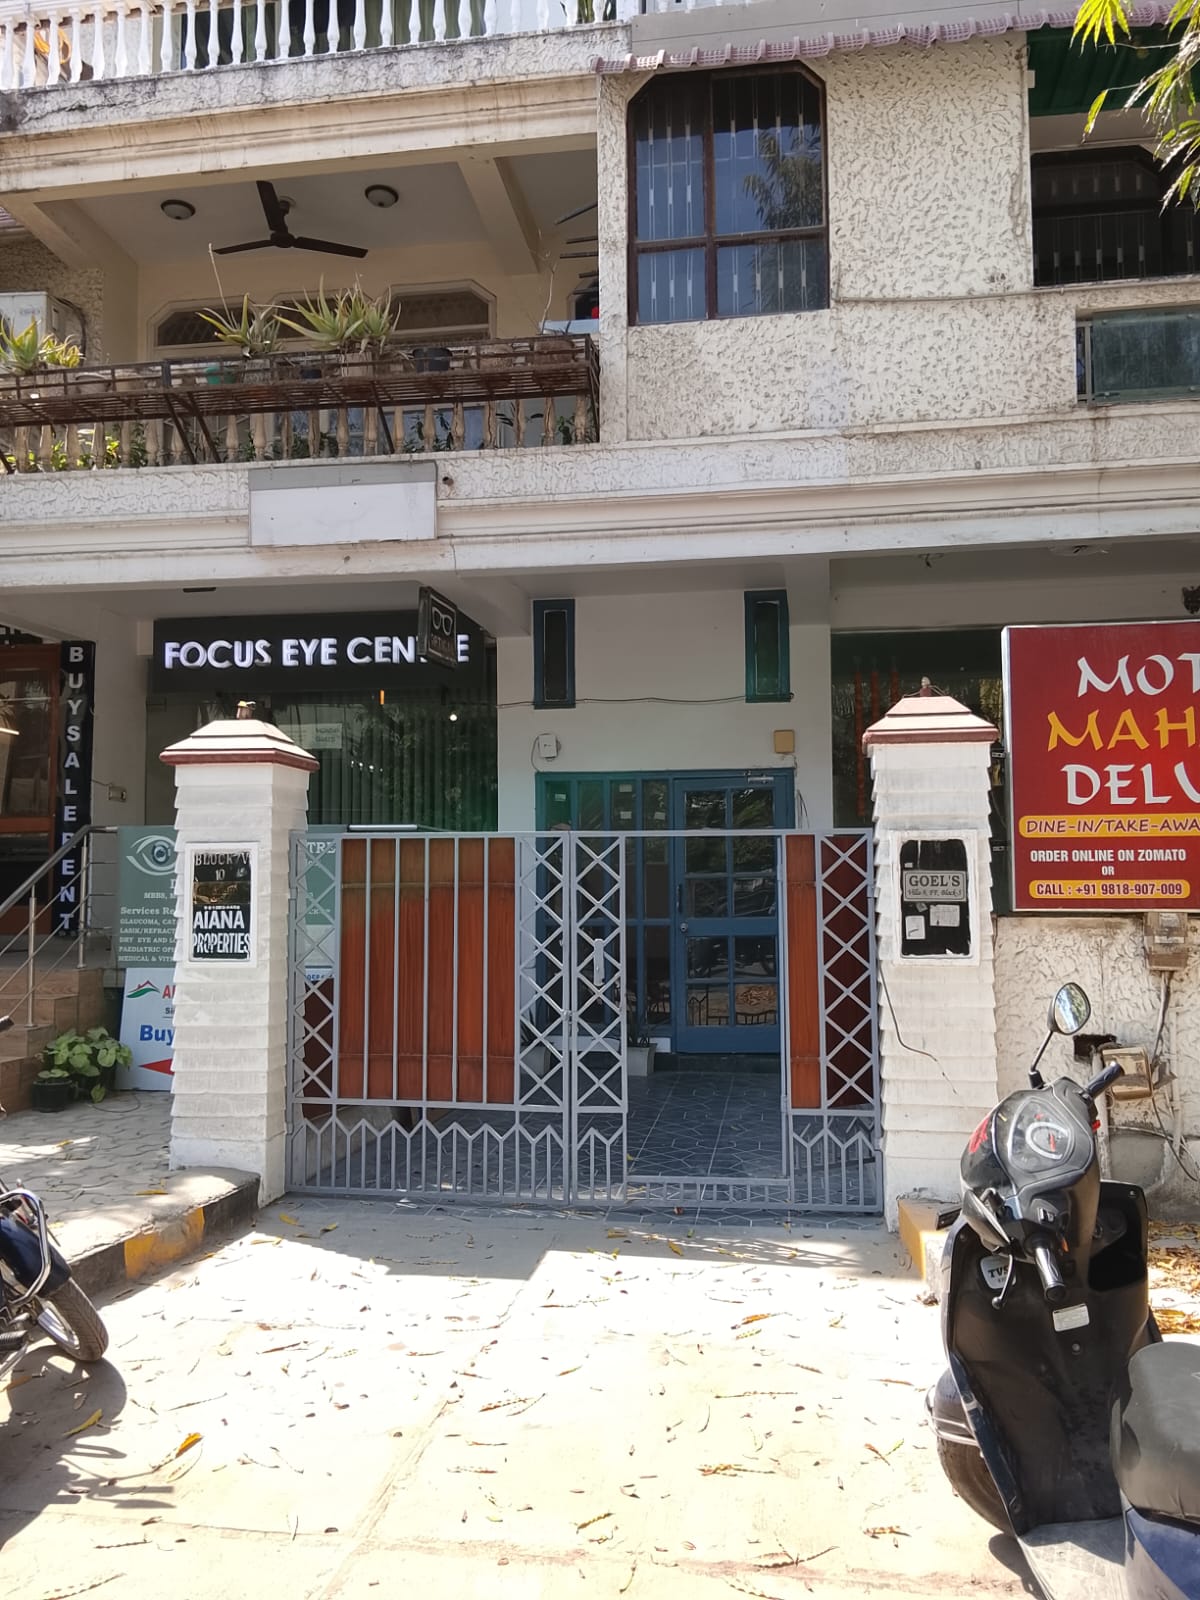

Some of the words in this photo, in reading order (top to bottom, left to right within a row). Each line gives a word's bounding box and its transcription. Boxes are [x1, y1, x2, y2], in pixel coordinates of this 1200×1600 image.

[164, 640, 271, 669] FOCUS
[282, 638, 337, 667] EYE
[347, 634, 469, 664] CENE
[1030, 850, 1069, 863] ORDER
[1072, 850, 1114, 862] ONLINE
[1117, 850, 1135, 861] ON
[1137, 849, 1187, 862] ZOMATO
[1101, 866, 1115, 876] OR
[909, 875, 960, 887] GOEL'S
[1036, 884, 1065, 895] CALL
[1075, 884, 1096, 895] +91
[1101, 883, 1182, 896] 9818-907-009
[120, 906, 160, 915] Services
[193, 911, 245, 929] AIANA
[193, 932, 251, 954] PROPERTIES
[140, 1024, 175, 1046] Buy
